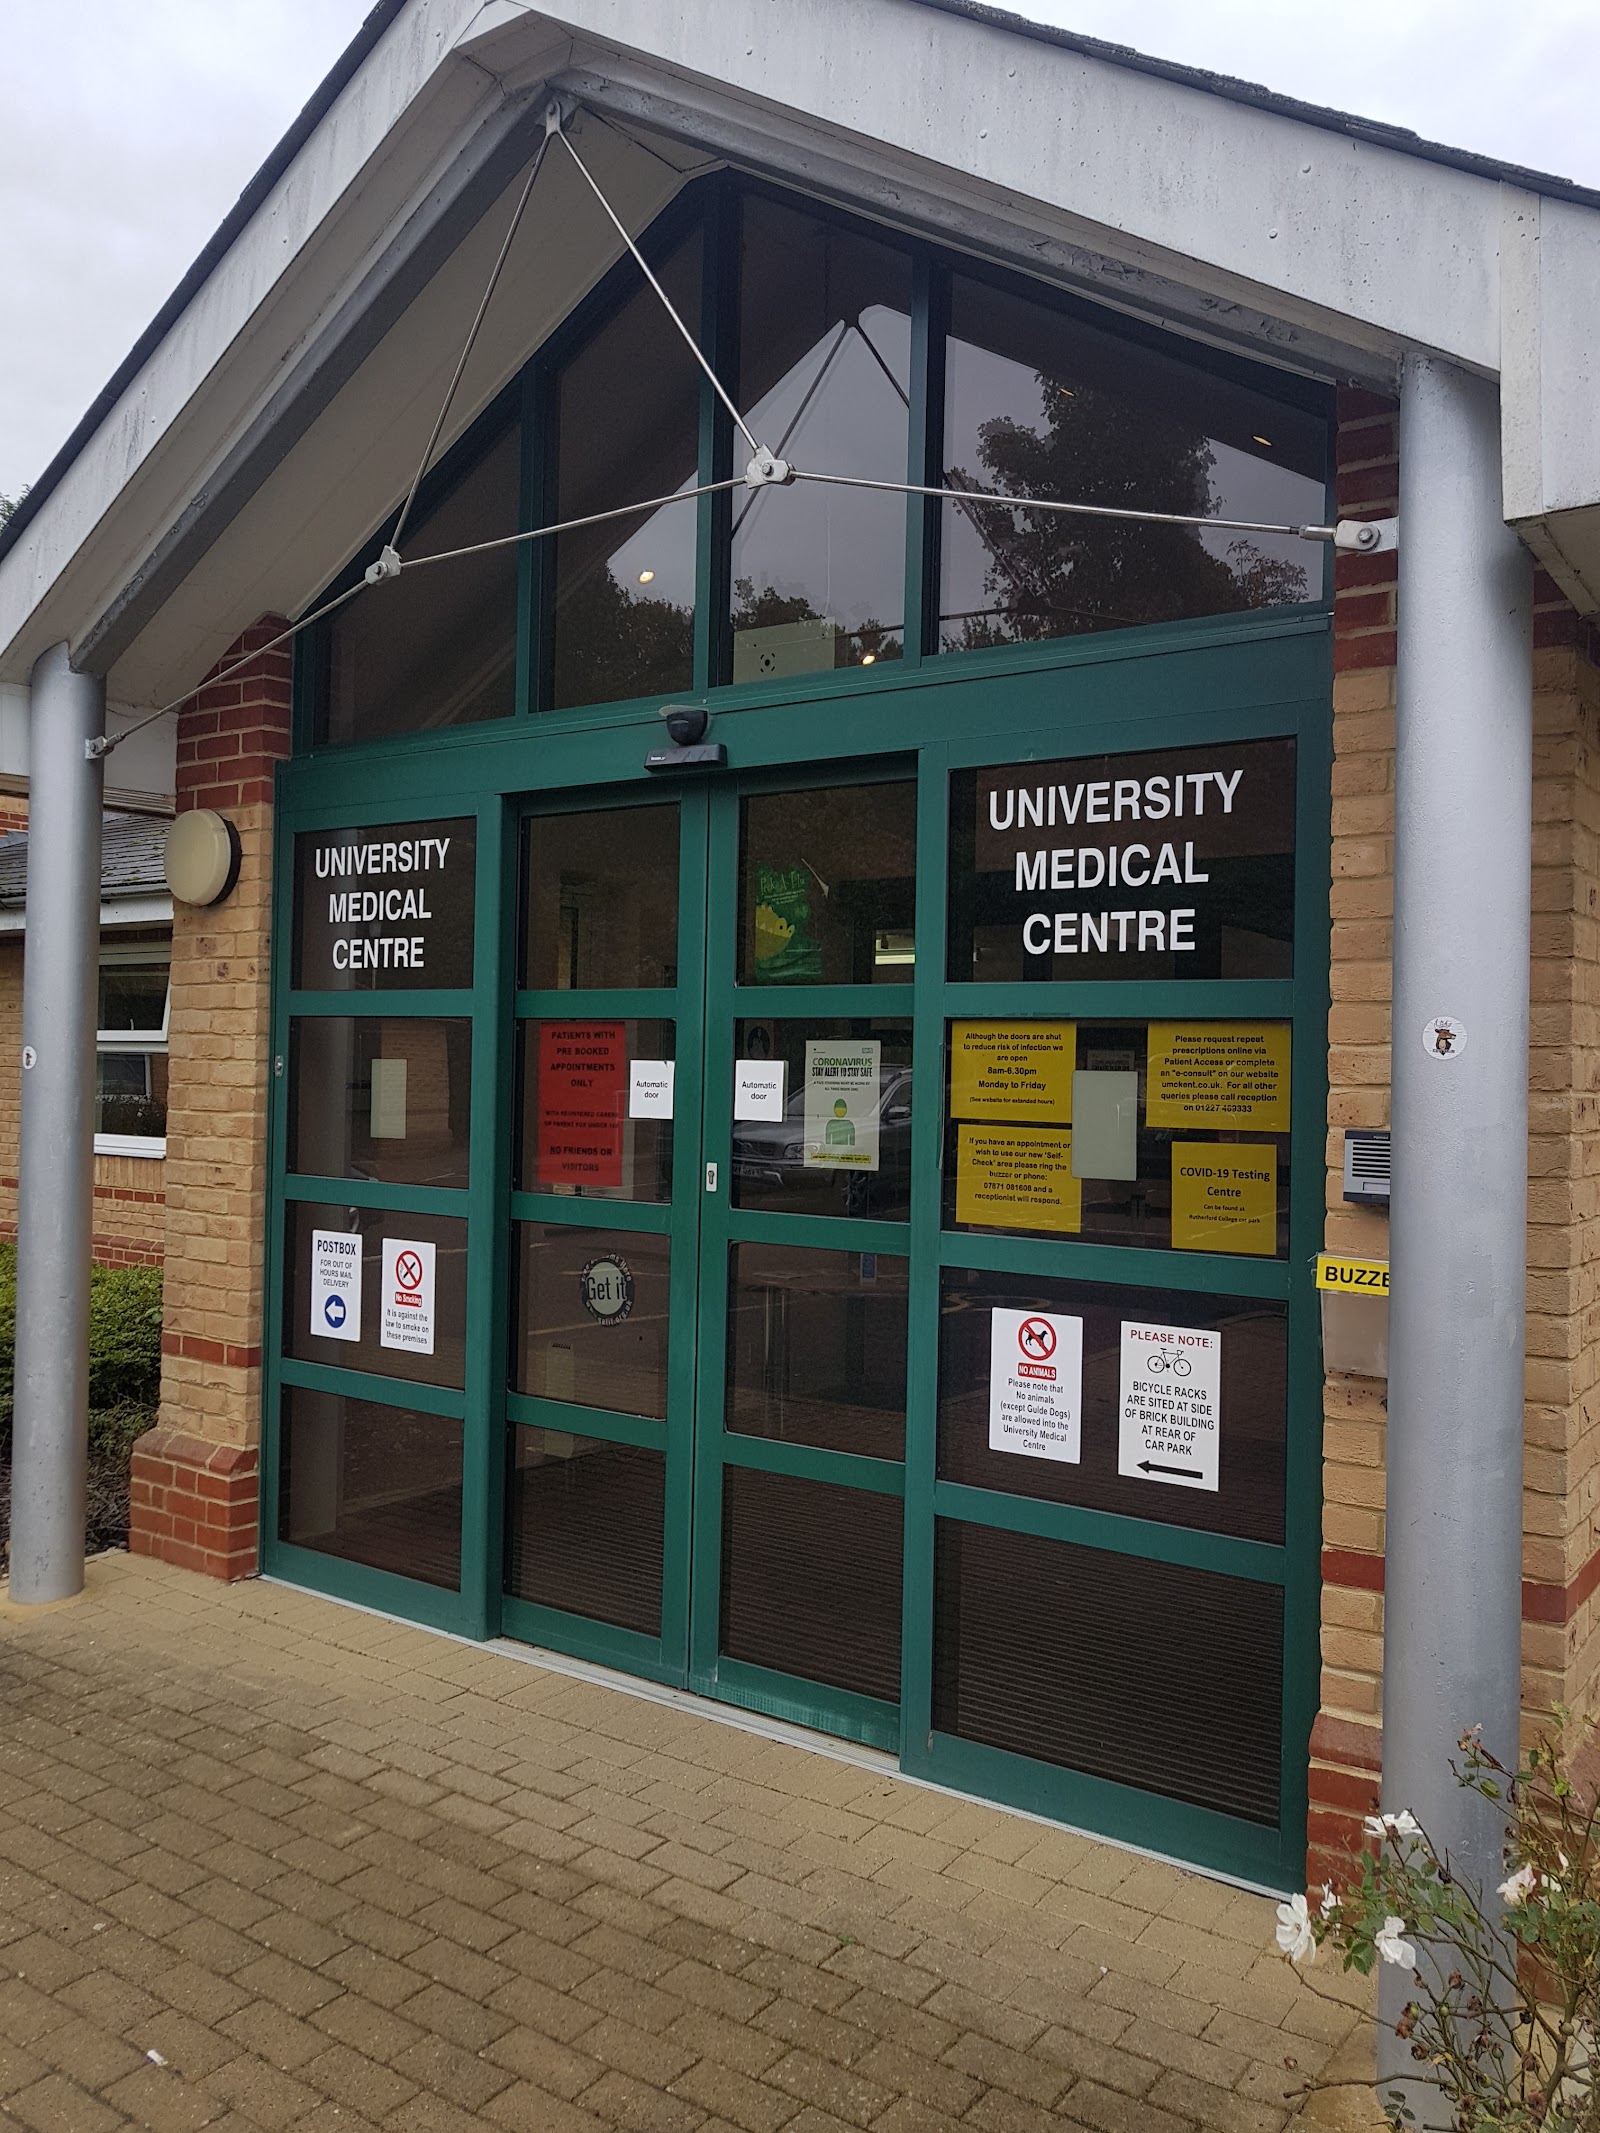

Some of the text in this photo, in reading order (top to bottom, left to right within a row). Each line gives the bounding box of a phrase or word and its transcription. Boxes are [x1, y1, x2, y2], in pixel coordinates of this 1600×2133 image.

[989, 769, 1244, 830] UNIVERSITY
[315, 838, 450, 878] UNIVERSITY
[1015, 841, 1209, 891] MEDICAL
[329, 889, 432, 923] MEDICAL
[1023, 908, 1196, 955] CENTRE
[332, 937, 424, 970] CENTRE
[551, 1031, 615, 1039] PATIENTS WITH
[966, 1033, 996, 1041] Although
[1175, 1035, 1264, 1044] Please request repeat
[1172, 1046, 1226, 1055] prescriptions
[551, 1063, 615, 1071] APPOINTMENTS
[813, 1058, 872, 1066] CORONAVIRUS
[1164, 1058, 1192, 1066] Patient
[1194, 1058, 1224, 1066] Access
[1236, 1059, 1275, 1067] complete
[812, 1067, 872, 1077] STAY ALERT TO STAY SAFE
[987, 1067, 1037, 1076] 8am-6.30pm
[1245, 1070, 1279, 1078] website
[571, 1079, 593, 1087] ONLY
[636, 1080, 668, 1088] Automatic
[742, 1081, 776, 1089] Automatic
[978, 1080, 1008, 1090] Monday
[1021, 1082, 1046, 1091] Friday
[1254, 1082, 1277, 1090] other
[644, 1090, 659, 1098] door
[751, 1092, 767, 1100] door
[1160, 1092, 1191, 1101] queries
[1192, 1093, 1219, 1101] please
[1237, 1094, 1277, 1103] reception
[1195, 1104, 1220, 1112] 01227
[989, 1138, 1005, 1146] have
[1017, 1140, 1061, 1149] appointment
[550, 1146, 612, 1156] NO FRIENDS OR
[976, 1148, 991, 1156] wish
[562, 1163, 599, 1172] VISITORS
[1014, 1161, 1037, 1169] please
[1039, 1162, 1053, 1171] ring
[1055, 1163, 1067, 1171] the
[989, 1170, 1012, 1178] buzzer
[1023, 1172, 1048, 1181] phone:
[1180, 1167, 1270, 1182] COVID-19 Testing
[983, 1182, 1004, 1190] 07871
[1207, 1186, 1242, 1197] Centre
[974, 1193, 1016, 1202] receptionist
[1030, 1196, 1062, 1206] respond.
[317, 1240, 356, 1255] POSTBOX
[320, 1259, 331, 1267] FOR
[332, 1260, 343, 1269] OUT
[320, 1269, 353, 1279] HOURS MAIL
[323, 1279, 349, 1288] DELIVERY
[587, 1276, 627, 1300] Get it
[395, 1293, 422, 1307] No Smoking
[398, 1311, 428, 1322] against the
[385, 1319, 394, 1327] law
[396, 1321, 401, 1329] to
[402, 1323, 420, 1332] smoke
[387, 1331, 427, 1344] these premises
[1130, 1330, 1213, 1348] PLEASE NOTE:
[1018, 1365, 1056, 1379] NO ANIMALS
[1008, 1378, 1064, 1393] Please note that
[1133, 1381, 1207, 1400] BICYCLE RACKS
[1016, 1391, 1055, 1405] No animals
[1000, 1400, 1071, 1420] (except Guide Dogs)
[1127, 1395, 1212, 1416] ARE SITED AT SIDE
[1001, 1414, 1069, 1430] are allowed into the
[1125, 1408, 1214, 1431] OF BRICK BUILDING
[1003, 1424, 1067, 1442] University Medical
[1141, 1425, 1196, 1442] AT REAR OF
[1023, 1439, 1046, 1451] Centre
[1145, 1439, 1192, 1456] CAR PARK
